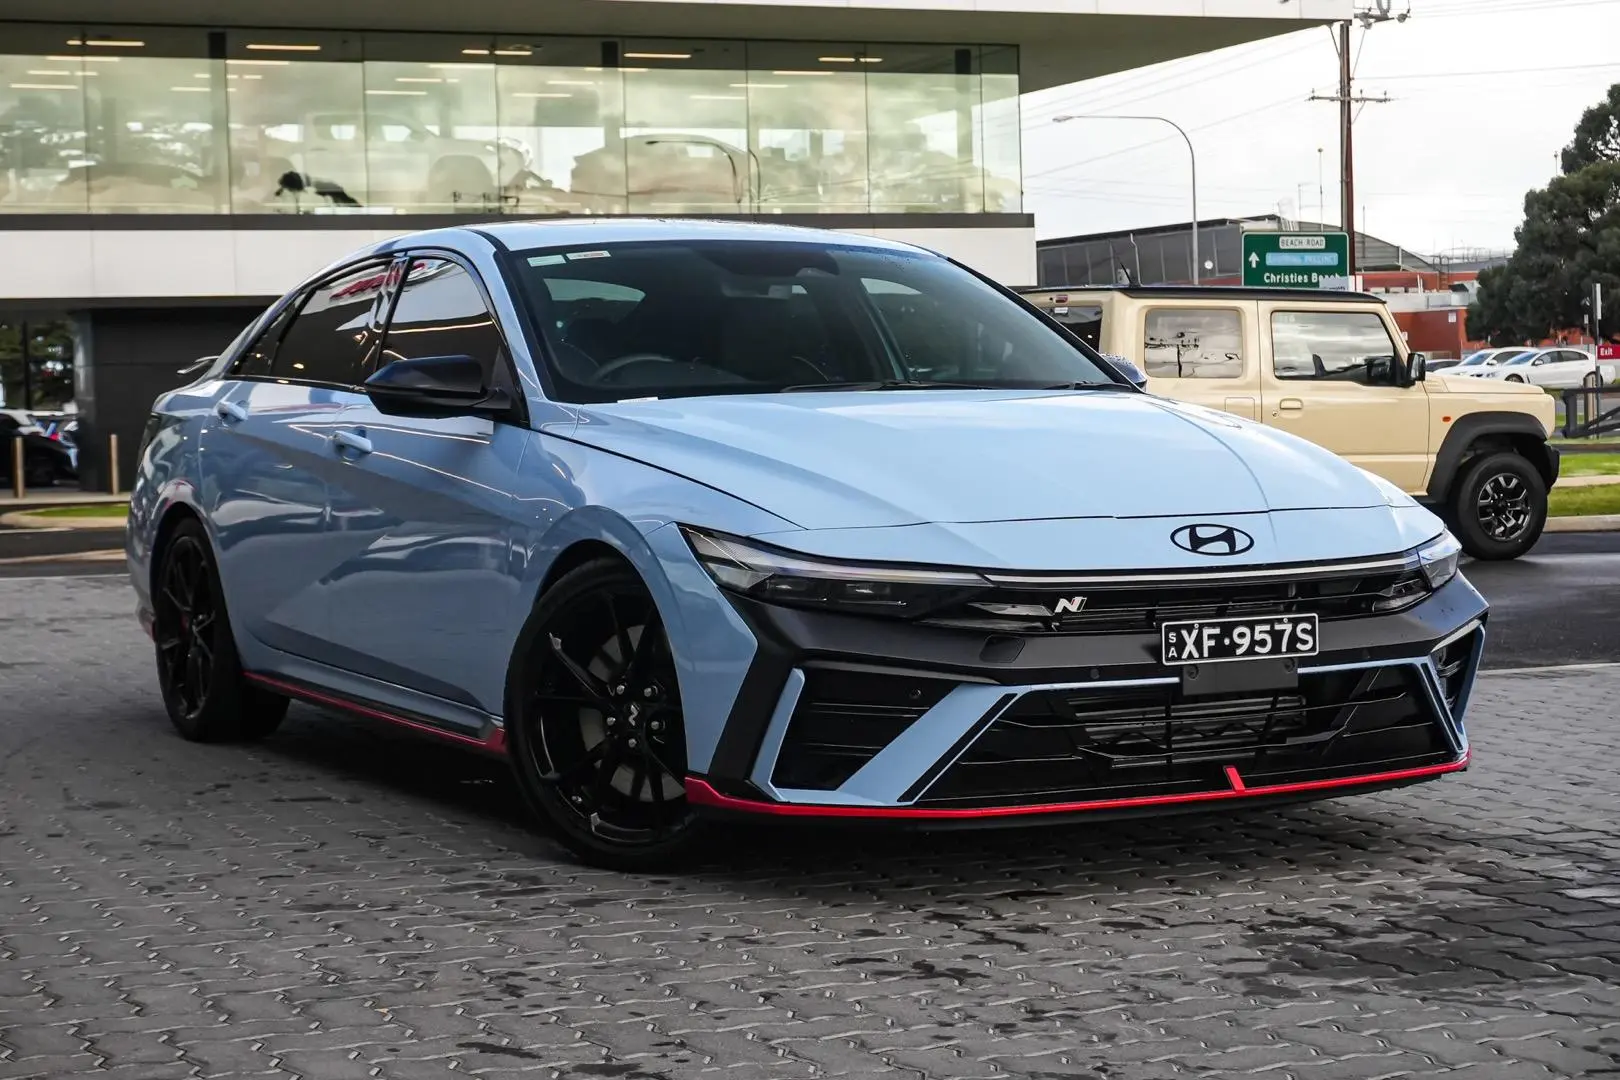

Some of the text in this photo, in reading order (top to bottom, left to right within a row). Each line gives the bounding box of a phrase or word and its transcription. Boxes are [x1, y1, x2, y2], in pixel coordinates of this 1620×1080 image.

[1280, 238, 1324, 247] BEACH ROAD
[1263, 272, 1308, 283] Christies
